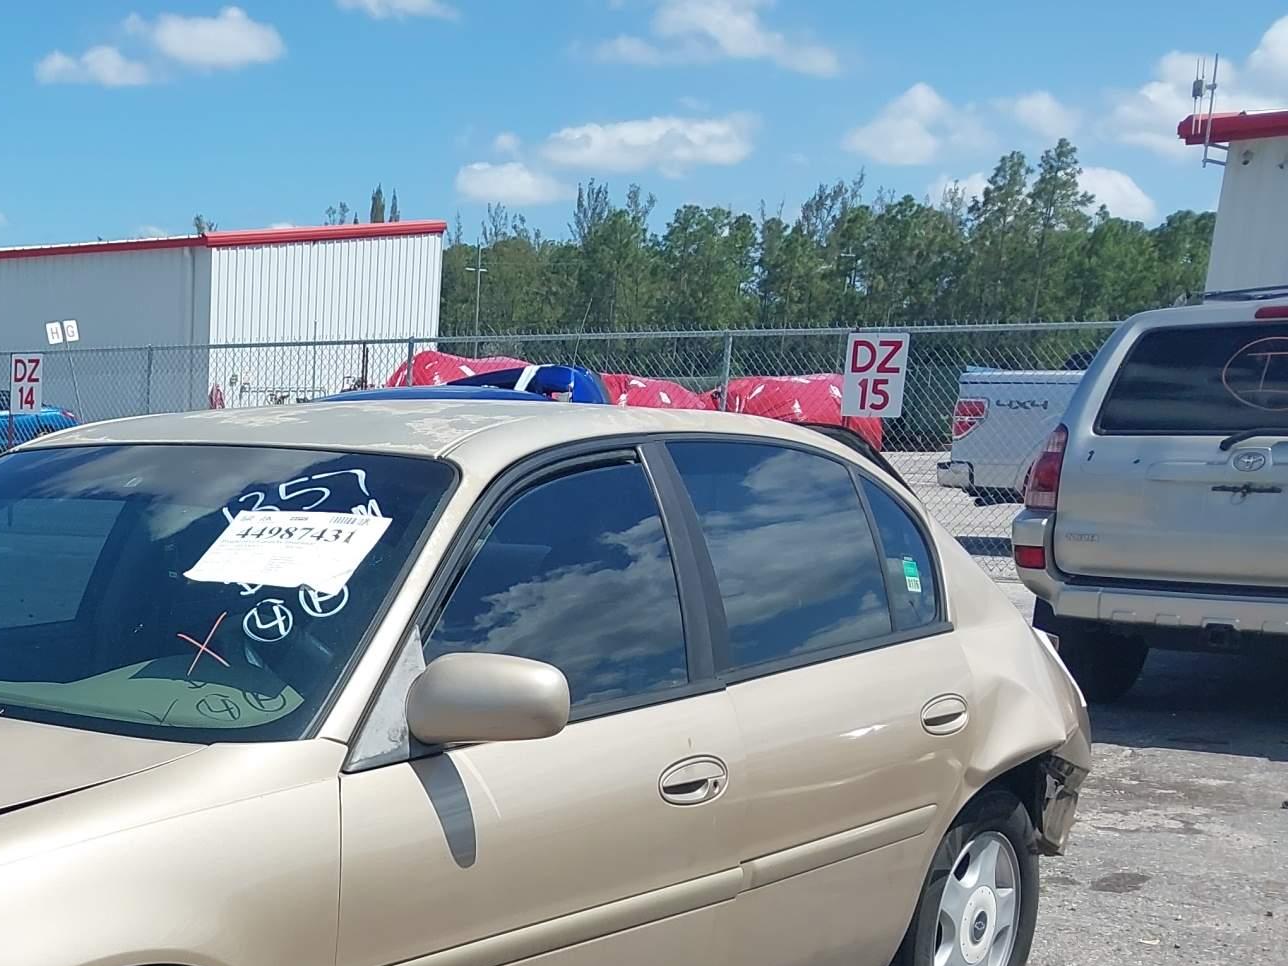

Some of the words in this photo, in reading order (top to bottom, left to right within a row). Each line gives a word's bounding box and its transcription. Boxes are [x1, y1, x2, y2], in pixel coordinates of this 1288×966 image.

[50, 326, 60, 340] H
[65, 325, 75, 338] G
[851, 340, 904, 374] DZ
[13, 358, 41, 383] DZ
[18, 386, 35, 410] 14
[857, 378, 890, 411] 15
[235, 526, 357, 545] 44987431
